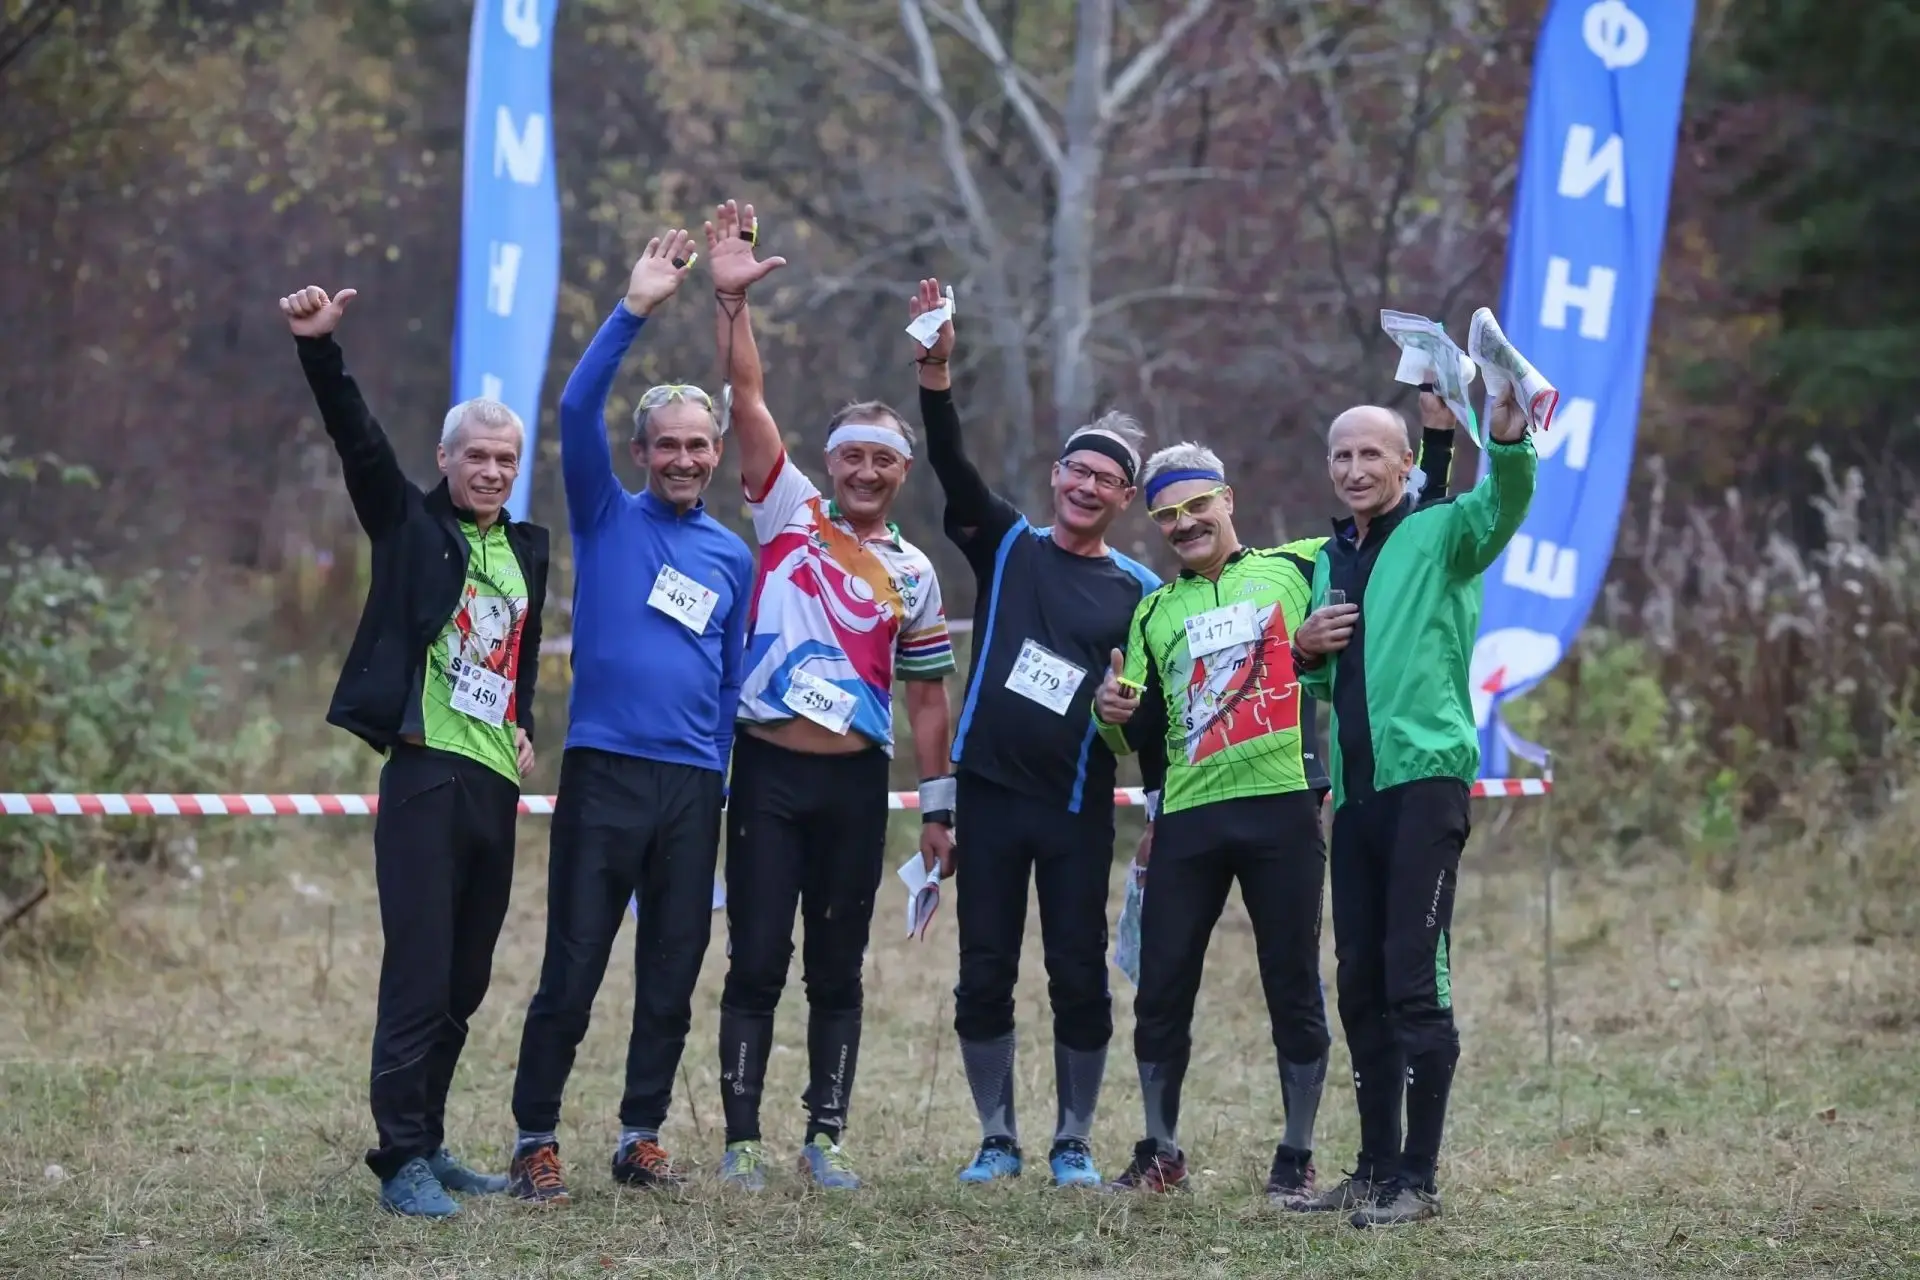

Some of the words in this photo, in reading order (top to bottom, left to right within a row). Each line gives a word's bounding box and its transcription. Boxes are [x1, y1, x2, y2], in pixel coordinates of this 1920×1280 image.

[1502, 0, 1650, 598] ФИНИШ
[667, 588, 697, 611] 487
[1205, 620, 1233, 640] 477
[451, 656, 462, 672] S
[1029, 668, 1060, 691] 479
[472, 687, 497, 707] 459
[1186, 717, 1194, 730] S
